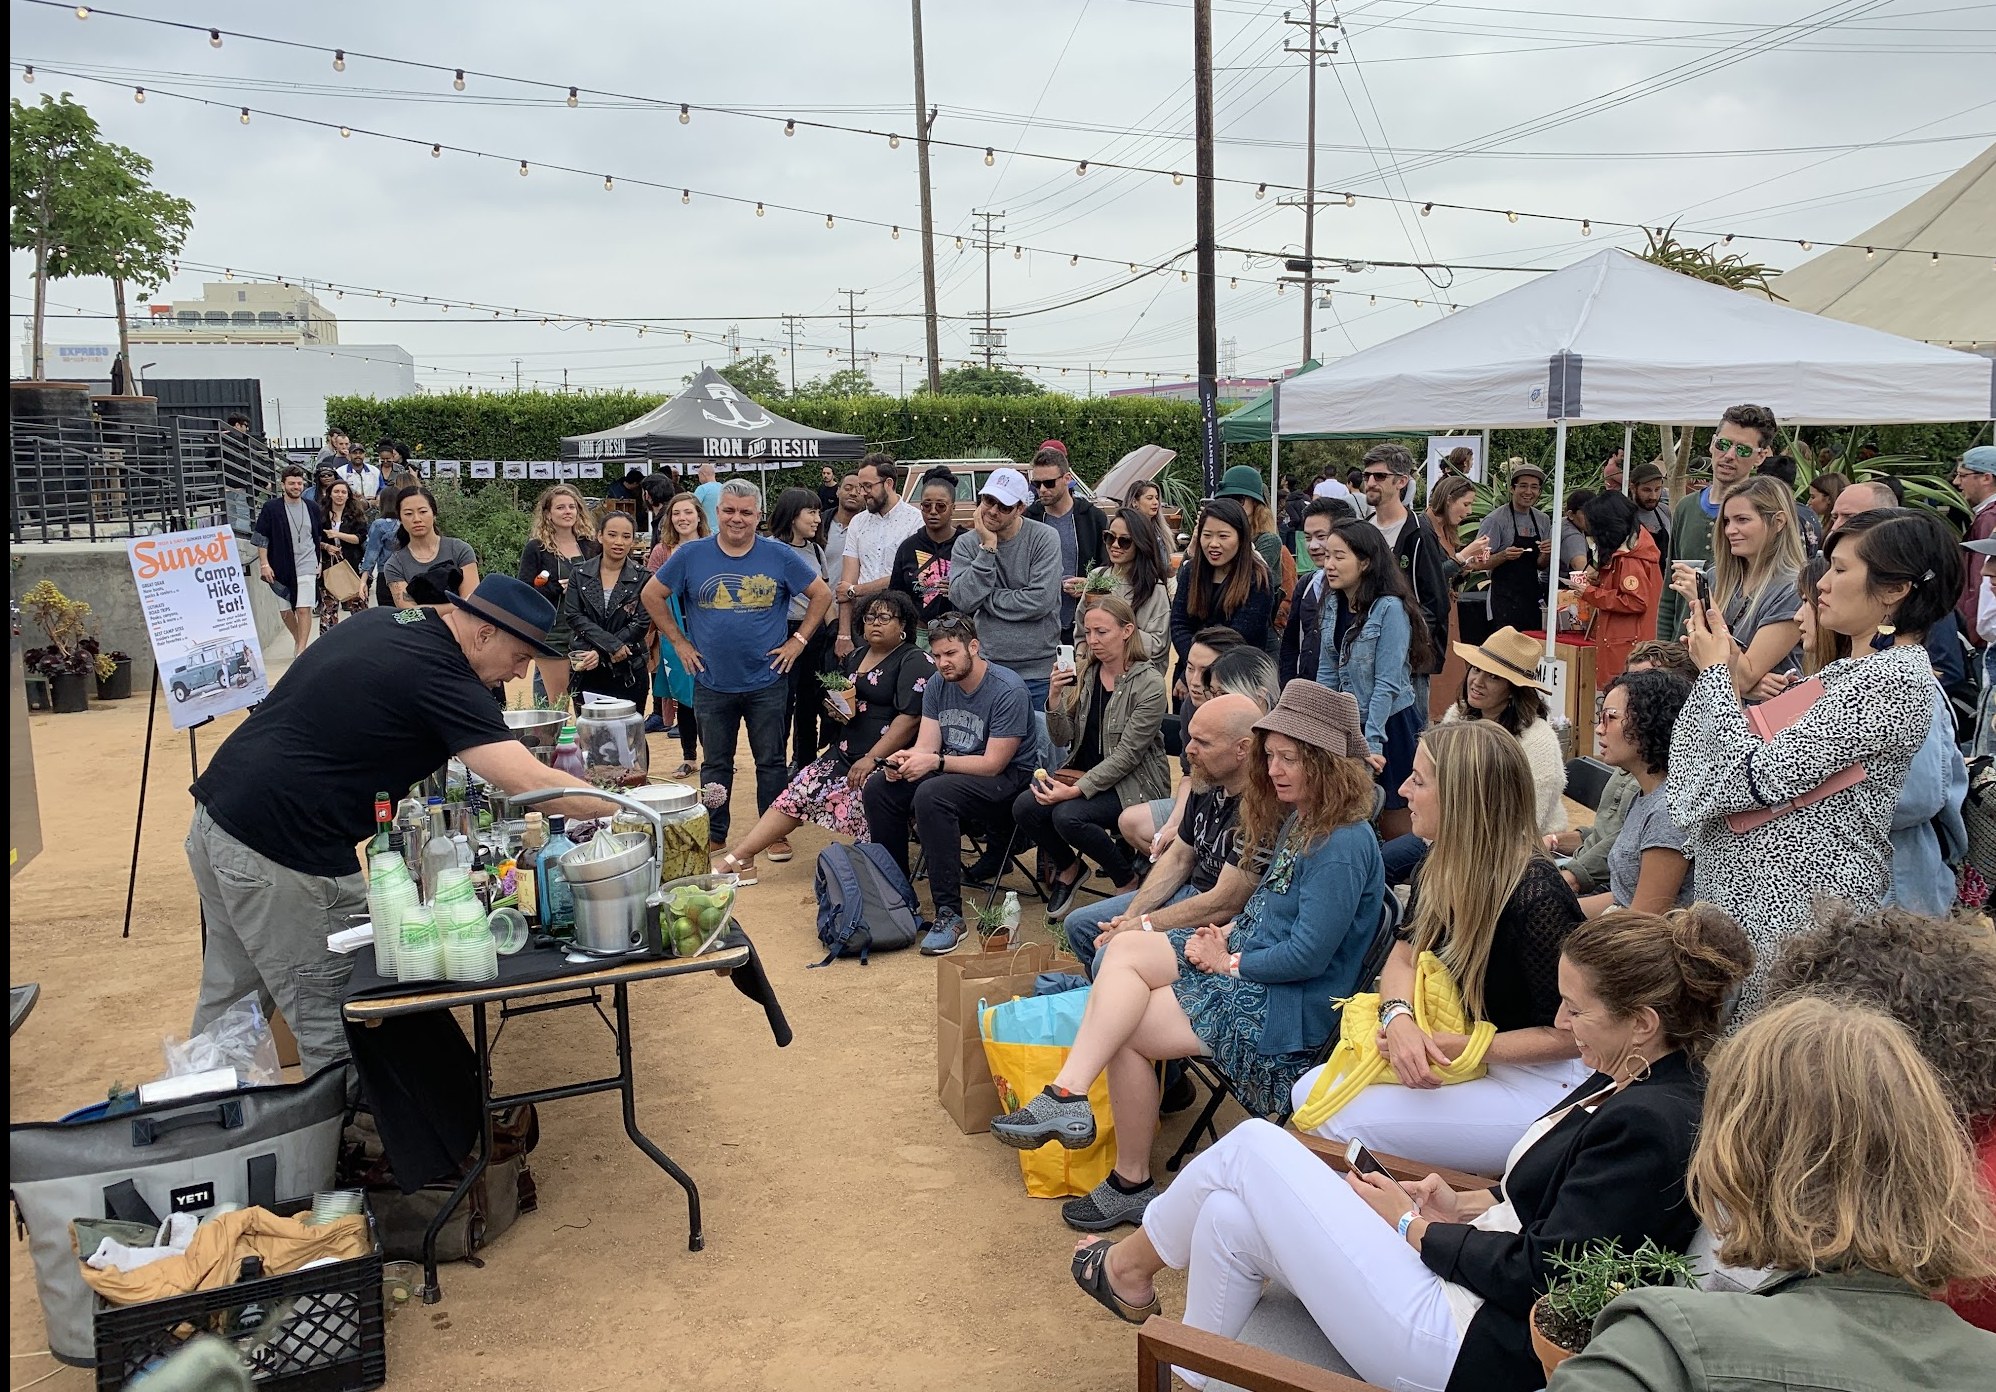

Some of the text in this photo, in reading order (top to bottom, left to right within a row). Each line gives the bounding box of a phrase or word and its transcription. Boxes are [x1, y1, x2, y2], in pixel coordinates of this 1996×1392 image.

[60, 347, 108, 356] EXPRESS
[579, 441, 594, 458] IRON
[604, 439, 626, 457] RESIN
[703, 438, 819, 458] IRON AND RESIN
[1207, 421, 1215, 487] ADVENTURE
[134, 532, 232, 578] Sunset
[195, 566, 239, 583] Camp,
[207, 580, 243, 599] Hike,
[217, 595, 244, 614] Eat!
[1535, 664, 1558, 685] ME
[176, 1191, 208, 1205] YETI
